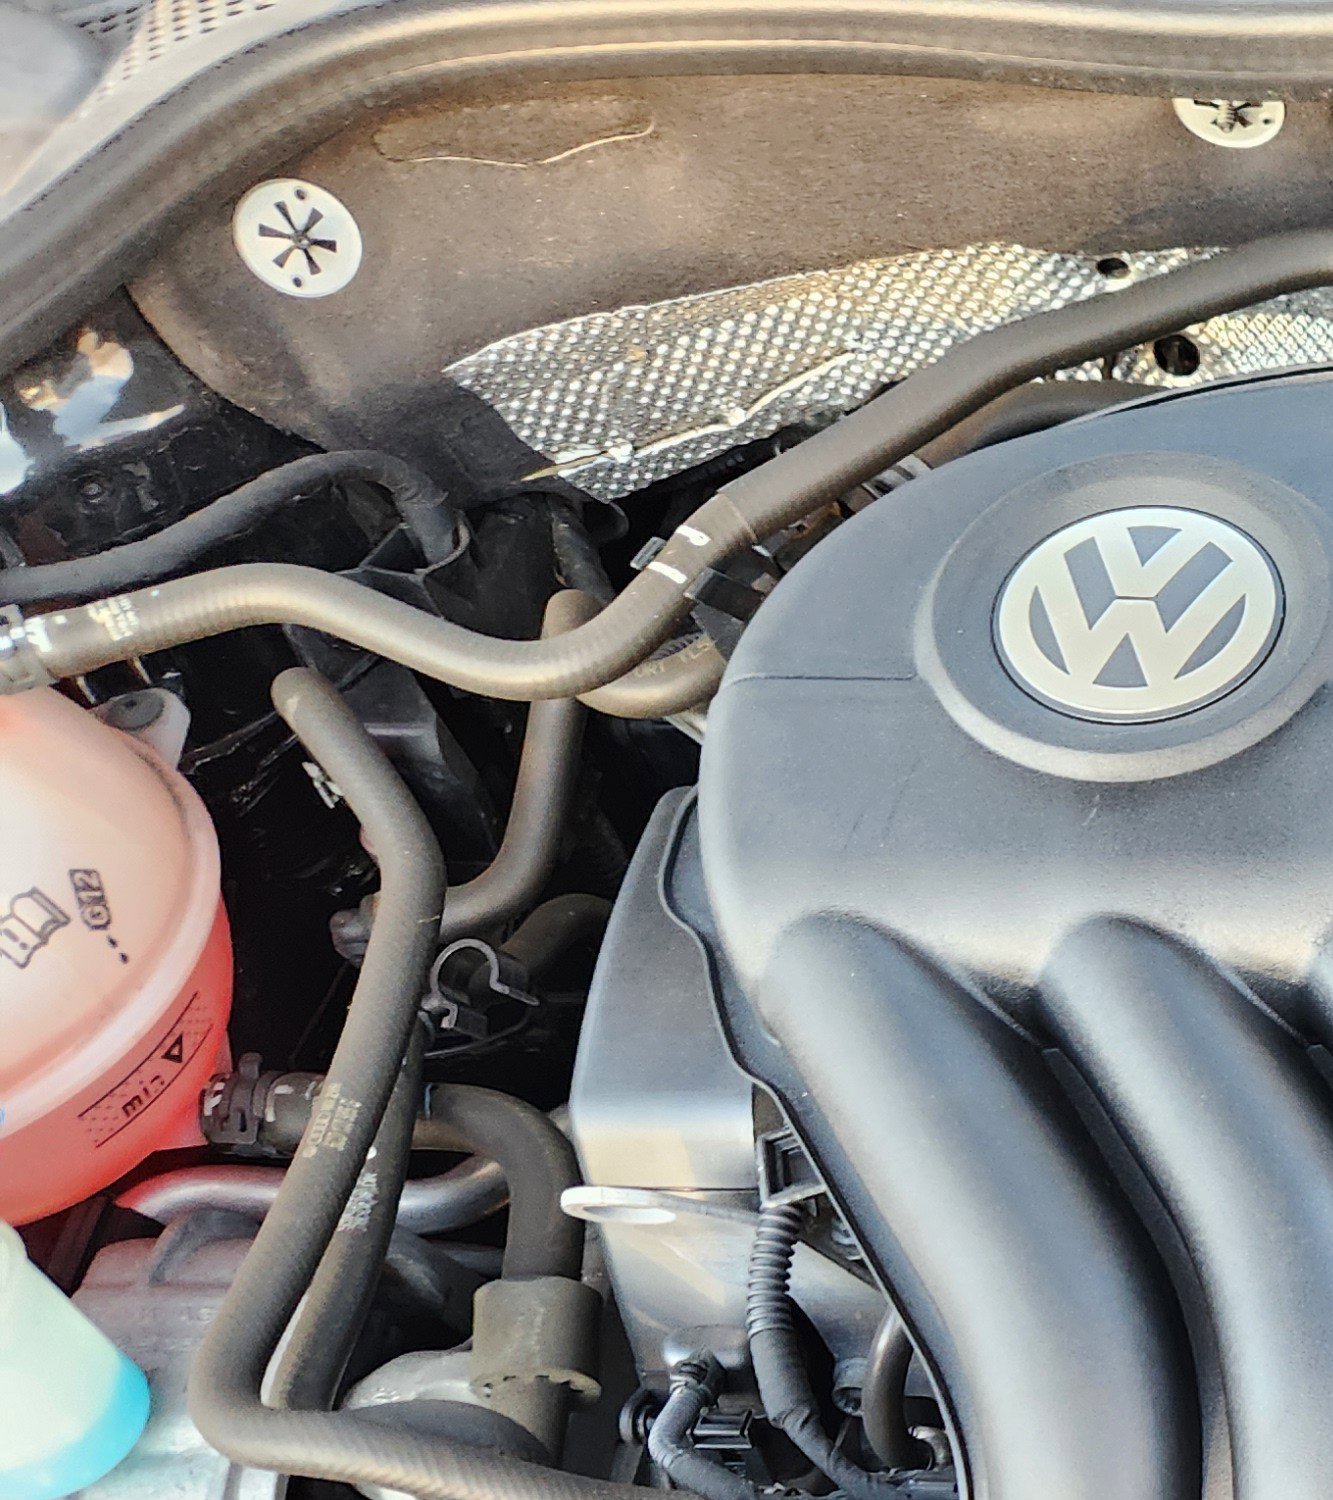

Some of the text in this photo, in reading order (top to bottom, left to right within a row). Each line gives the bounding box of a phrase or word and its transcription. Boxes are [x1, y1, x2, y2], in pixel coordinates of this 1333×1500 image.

[1001, 509, 1275, 714] VW
[69, 868, 112, 931] G12
[120, 1073, 166, 1118] min
